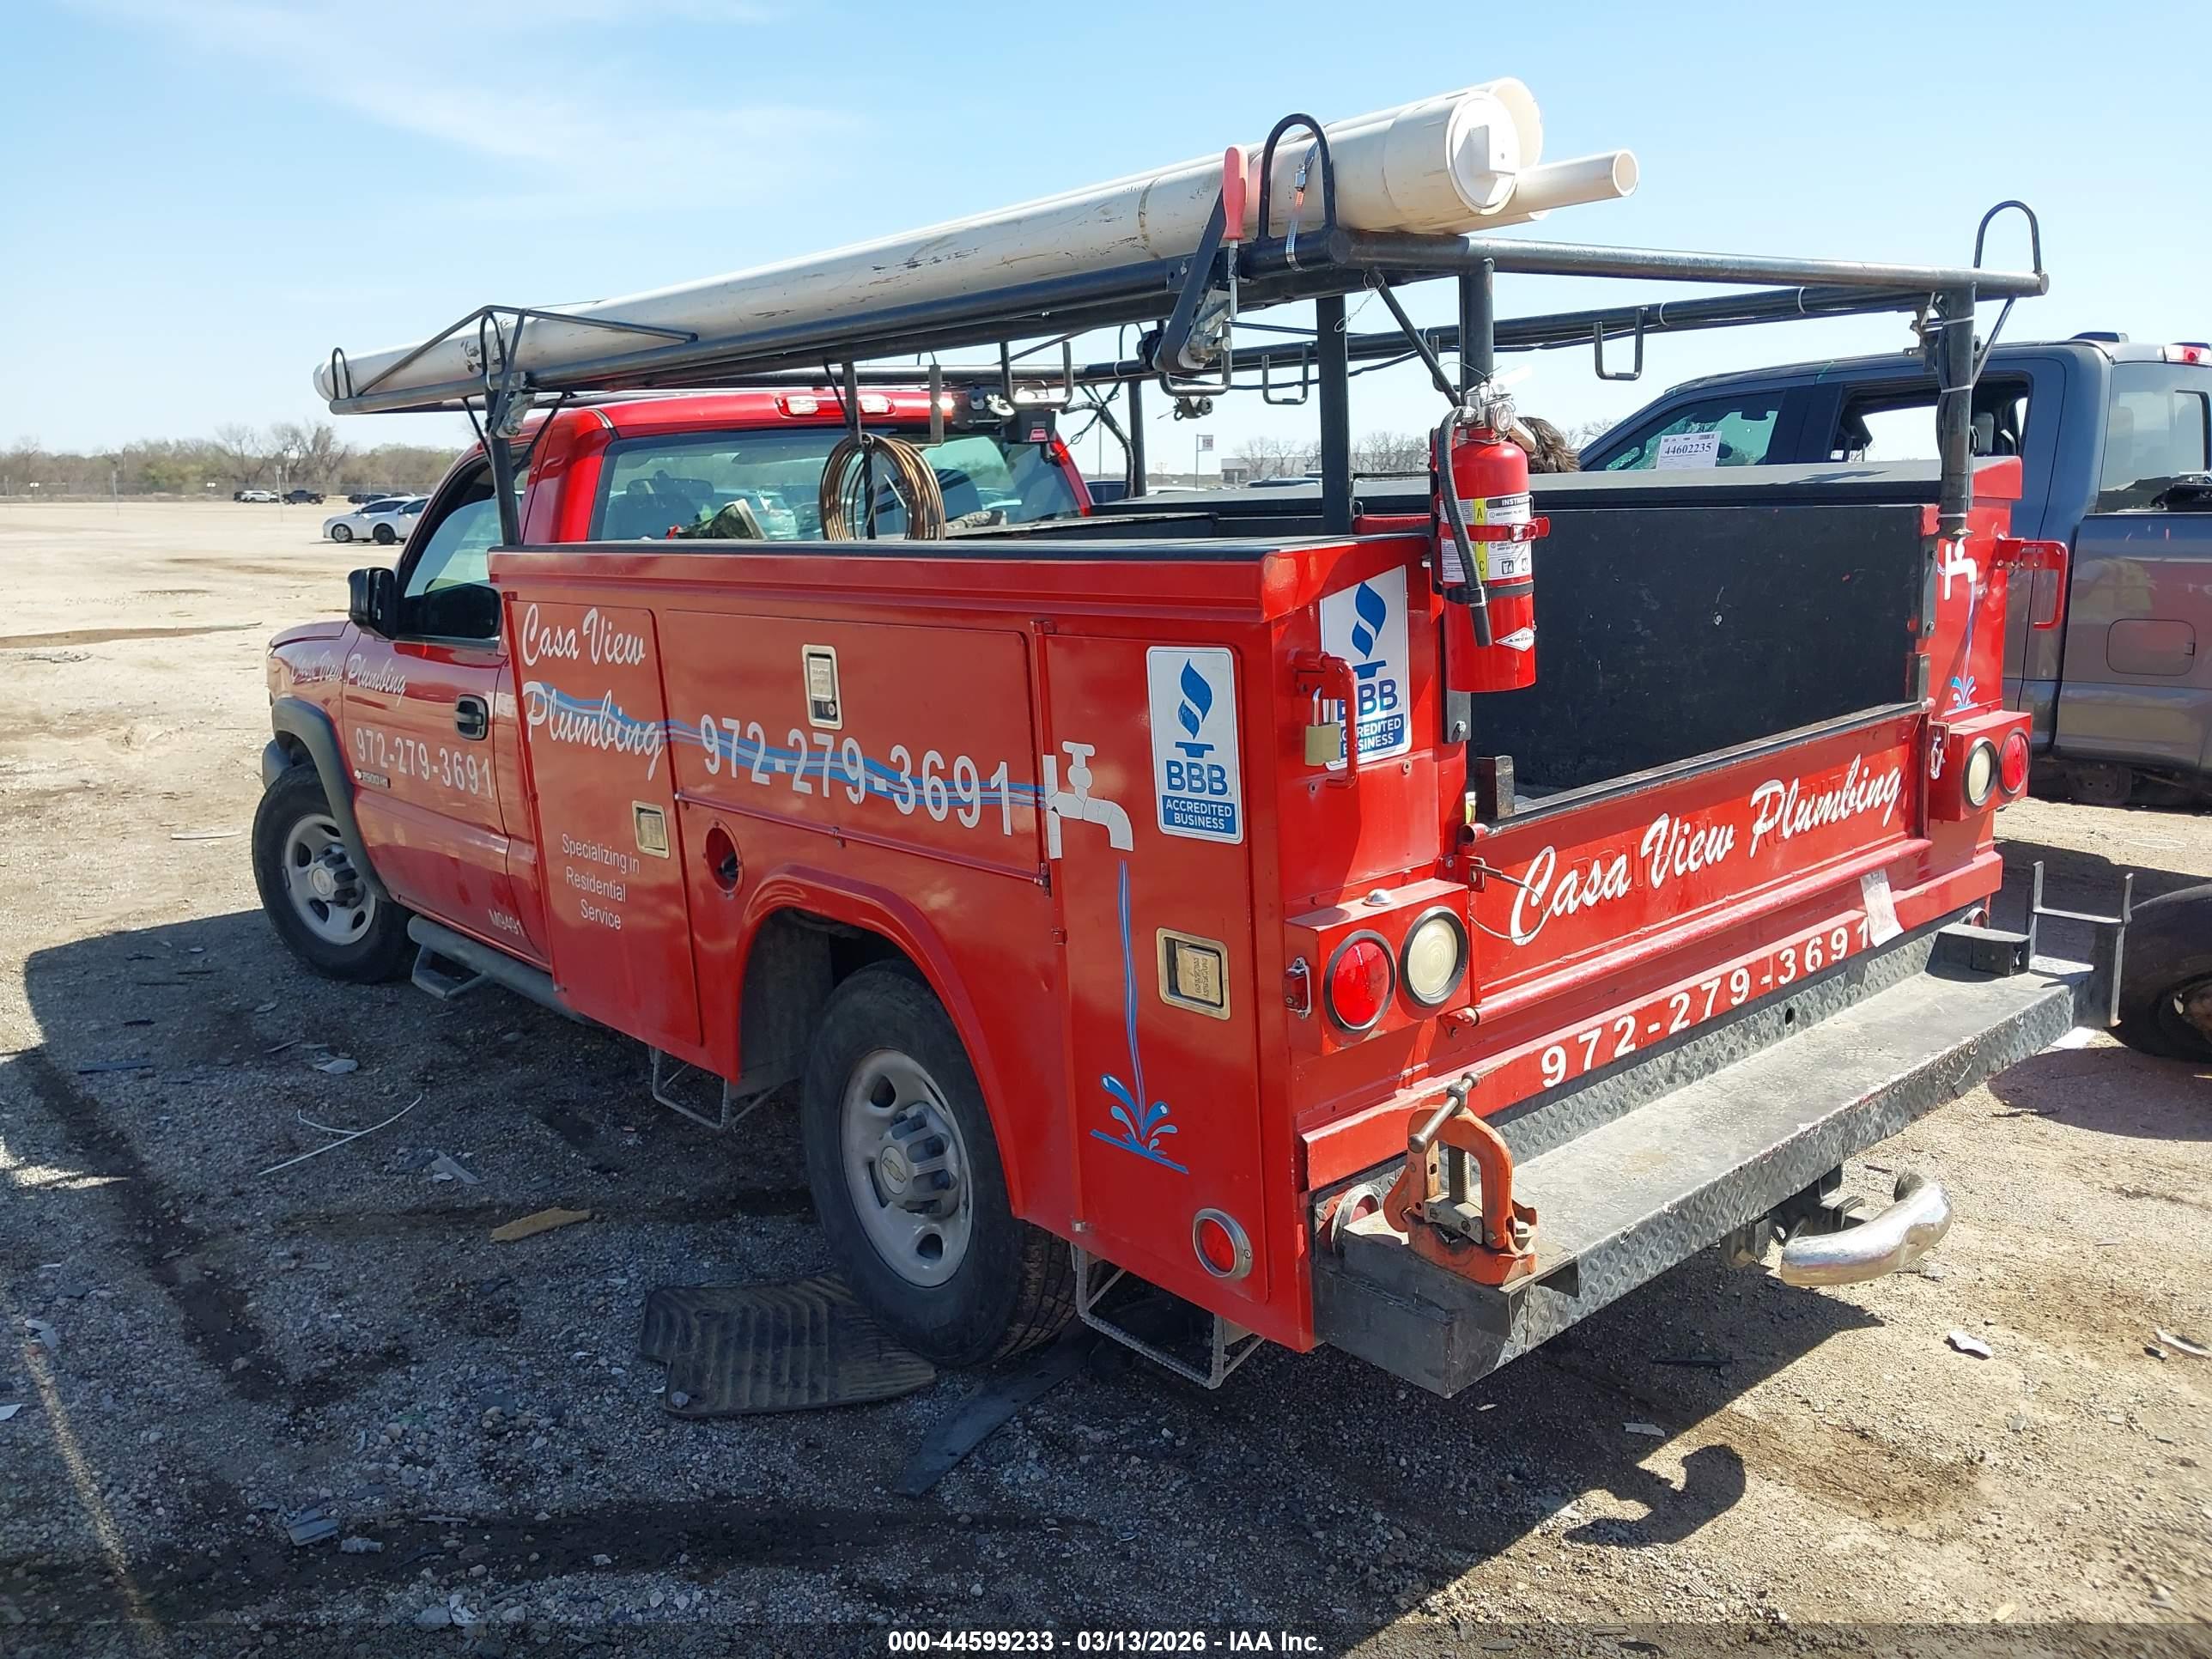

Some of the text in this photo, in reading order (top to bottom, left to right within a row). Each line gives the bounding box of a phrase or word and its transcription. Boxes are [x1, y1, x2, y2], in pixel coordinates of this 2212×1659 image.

[1665, 442, 1712, 455] 44602235
[522, 603, 646, 667] Casa View
[346, 653, 406, 707] Plumbing
[1337, 679, 1398, 721] BB
[522, 680, 665, 781] Plumbing
[356, 727, 493, 799] 972-279-3691
[700, 714, 1012, 836] 972-279-3691
[1166, 759, 1228, 796] BBB
[1165, 798, 1233, 818] ACCREDITED
[1174, 812, 1225, 831] BUSINESS
[562, 833, 626, 875] Specializing
[628, 855, 640, 874] in
[1510, 844, 1632, 946] Casa
[1641, 812, 1735, 889] View
[1750, 753, 1902, 859] Plumbing
[565, 866, 627, 903] Residential
[580, 898, 622, 931] Service
[1540, 915, 1869, 1089] 972-279-3691
